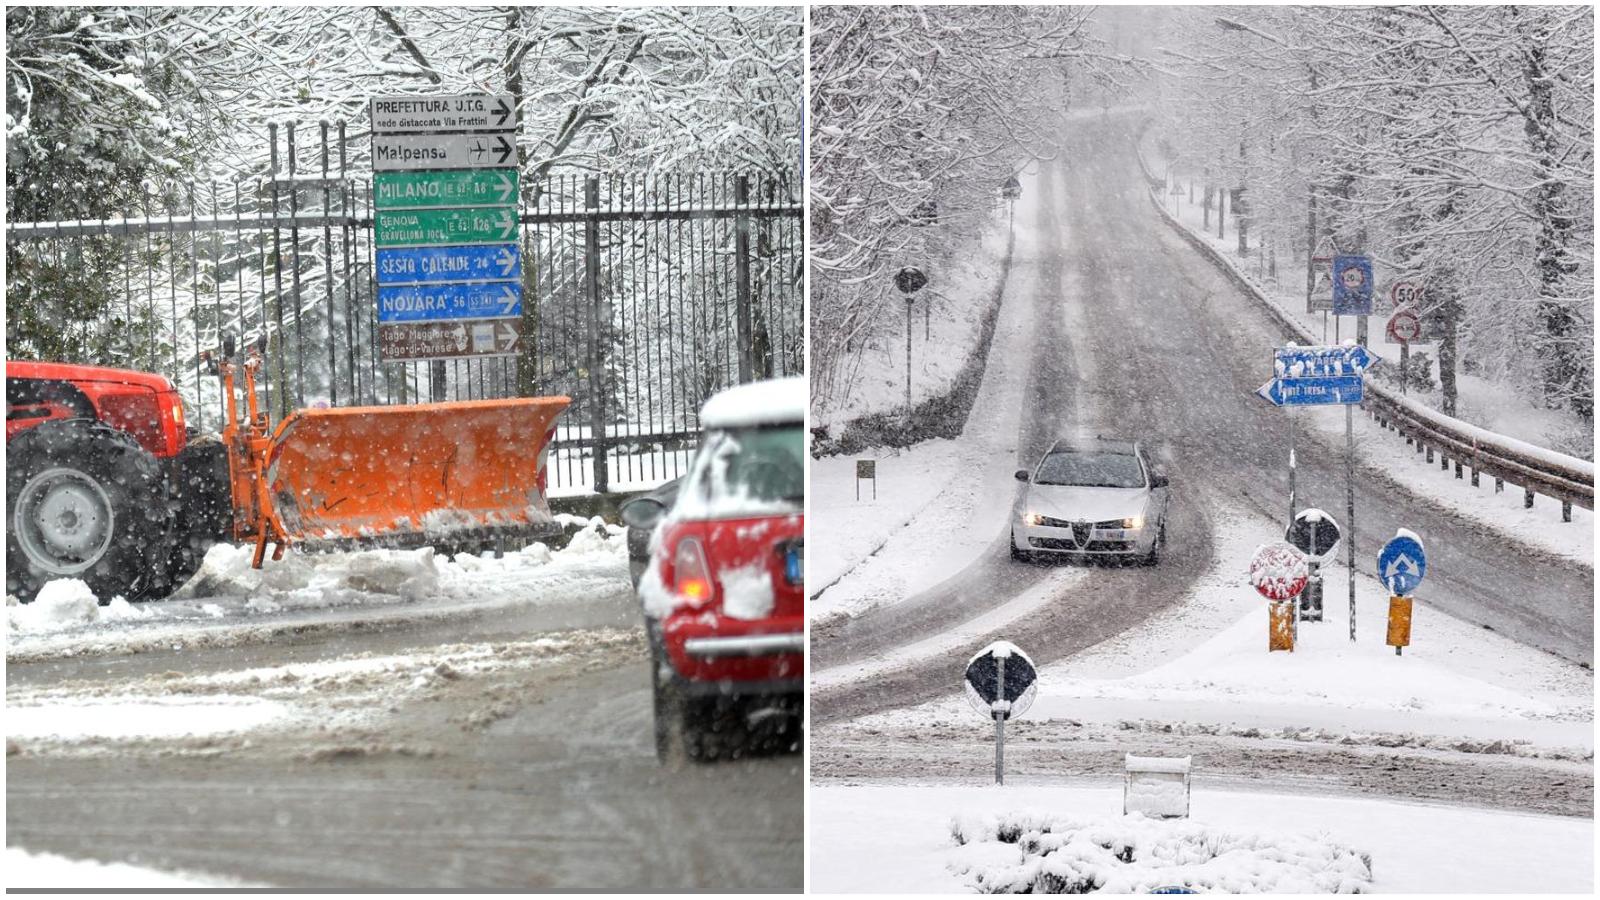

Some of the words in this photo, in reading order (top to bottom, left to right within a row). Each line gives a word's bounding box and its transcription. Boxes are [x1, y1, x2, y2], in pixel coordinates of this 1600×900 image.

[376, 100, 450, 113] PREFETTURA
[455, 100, 487, 112] U.T.G.
[377, 119, 397, 128] sede
[399, 118, 441, 127] distaccata
[443, 117, 456, 126] Via
[458, 117, 488, 125] Frattini
[377, 145, 447, 162] Malpensa
[380, 182, 439, 198] MILANO
[474, 182, 487, 194] A8
[380, 215, 419, 226] GENOVA
[473, 217, 490, 231] A26
[381, 259, 416, 274] SESTO
[421, 256, 470, 272] CALENDE
[383, 296, 446, 312] NOVARA
[453, 296, 465, 308] 56
[1398, 289, 1415, 303] 50
[409, 344, 417, 354] di
[421, 343, 453, 354] Varese
